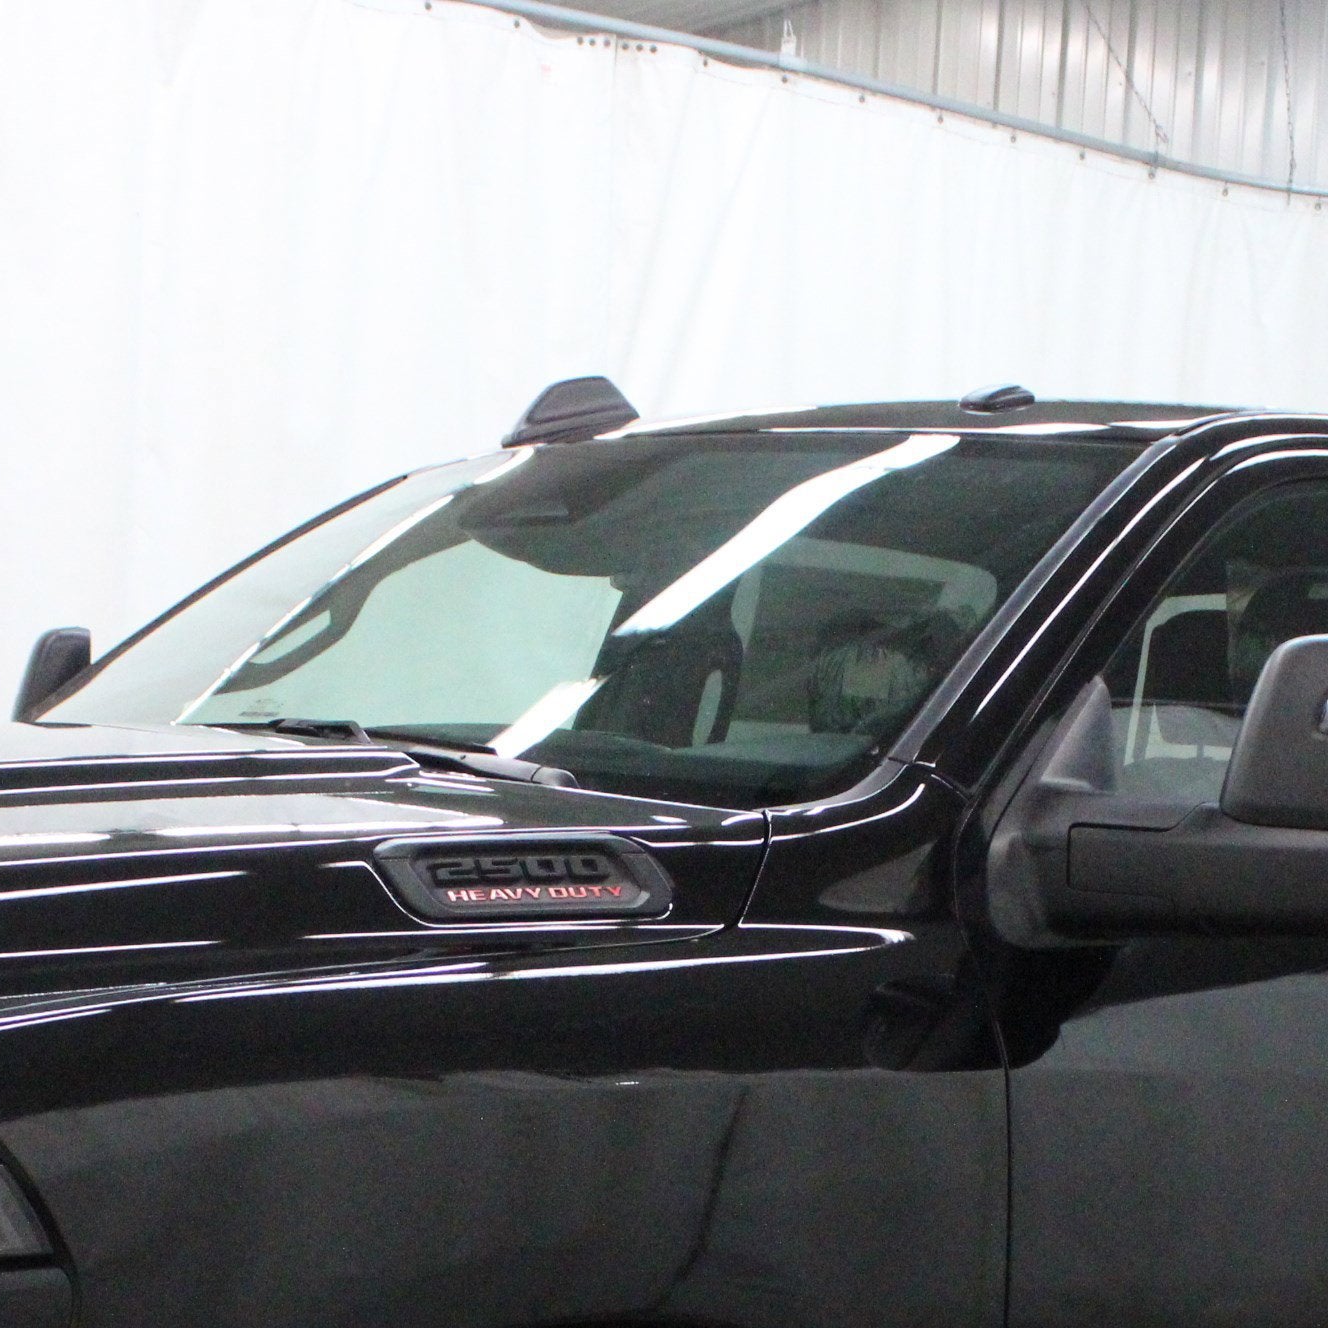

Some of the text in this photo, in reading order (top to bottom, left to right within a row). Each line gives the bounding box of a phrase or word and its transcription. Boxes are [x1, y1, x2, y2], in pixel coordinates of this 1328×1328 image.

[426, 857, 611, 885] 2500
[447, 885, 623, 902] HEAVY DUTY
